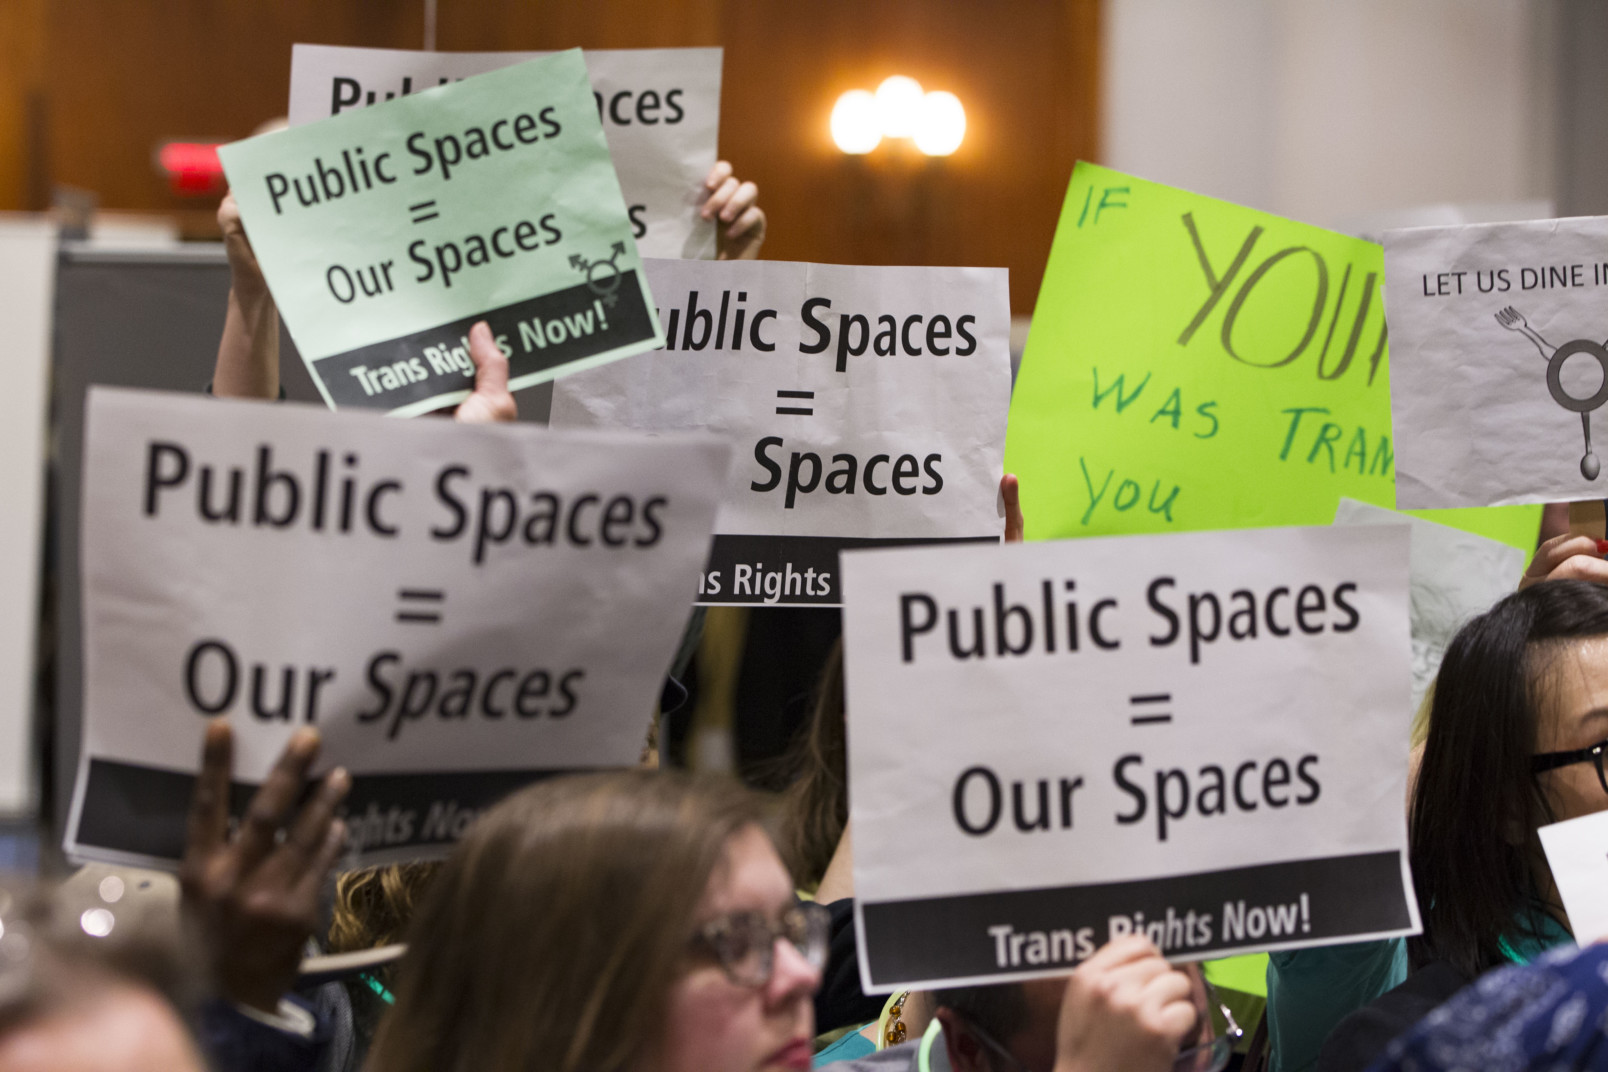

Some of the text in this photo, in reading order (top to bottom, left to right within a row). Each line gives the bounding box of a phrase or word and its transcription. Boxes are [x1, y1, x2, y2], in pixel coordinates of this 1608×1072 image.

[264, 104, 563, 214] Public Spaces
[1077, 185, 1131, 229] IF
[325, 259, 395, 304] Our
[407, 211, 564, 285] Spaces
[1176, 211, 1389, 388] YOU
[1423, 272, 1467, 297] LET
[1477, 269, 1511, 293] US
[1521, 264, 1585, 291] DINE
[349, 299, 609, 397] Trans Rigs Now!
[654, 290, 977, 373] ublic Spaces
[1092, 366, 1396, 483] WAS TRAN
[142, 440, 669, 566] Public Spaces
[750, 436, 944, 509] Spaces
[733, 562, 831, 604] Rights
[898, 575, 1360, 665] Public Spaces
[183, 637, 586, 742] Our Spaces
[951, 752, 1322, 842] Our Spaces
[987, 924, 1095, 968] Trans
[1222, 892, 1311, 942] Now!
